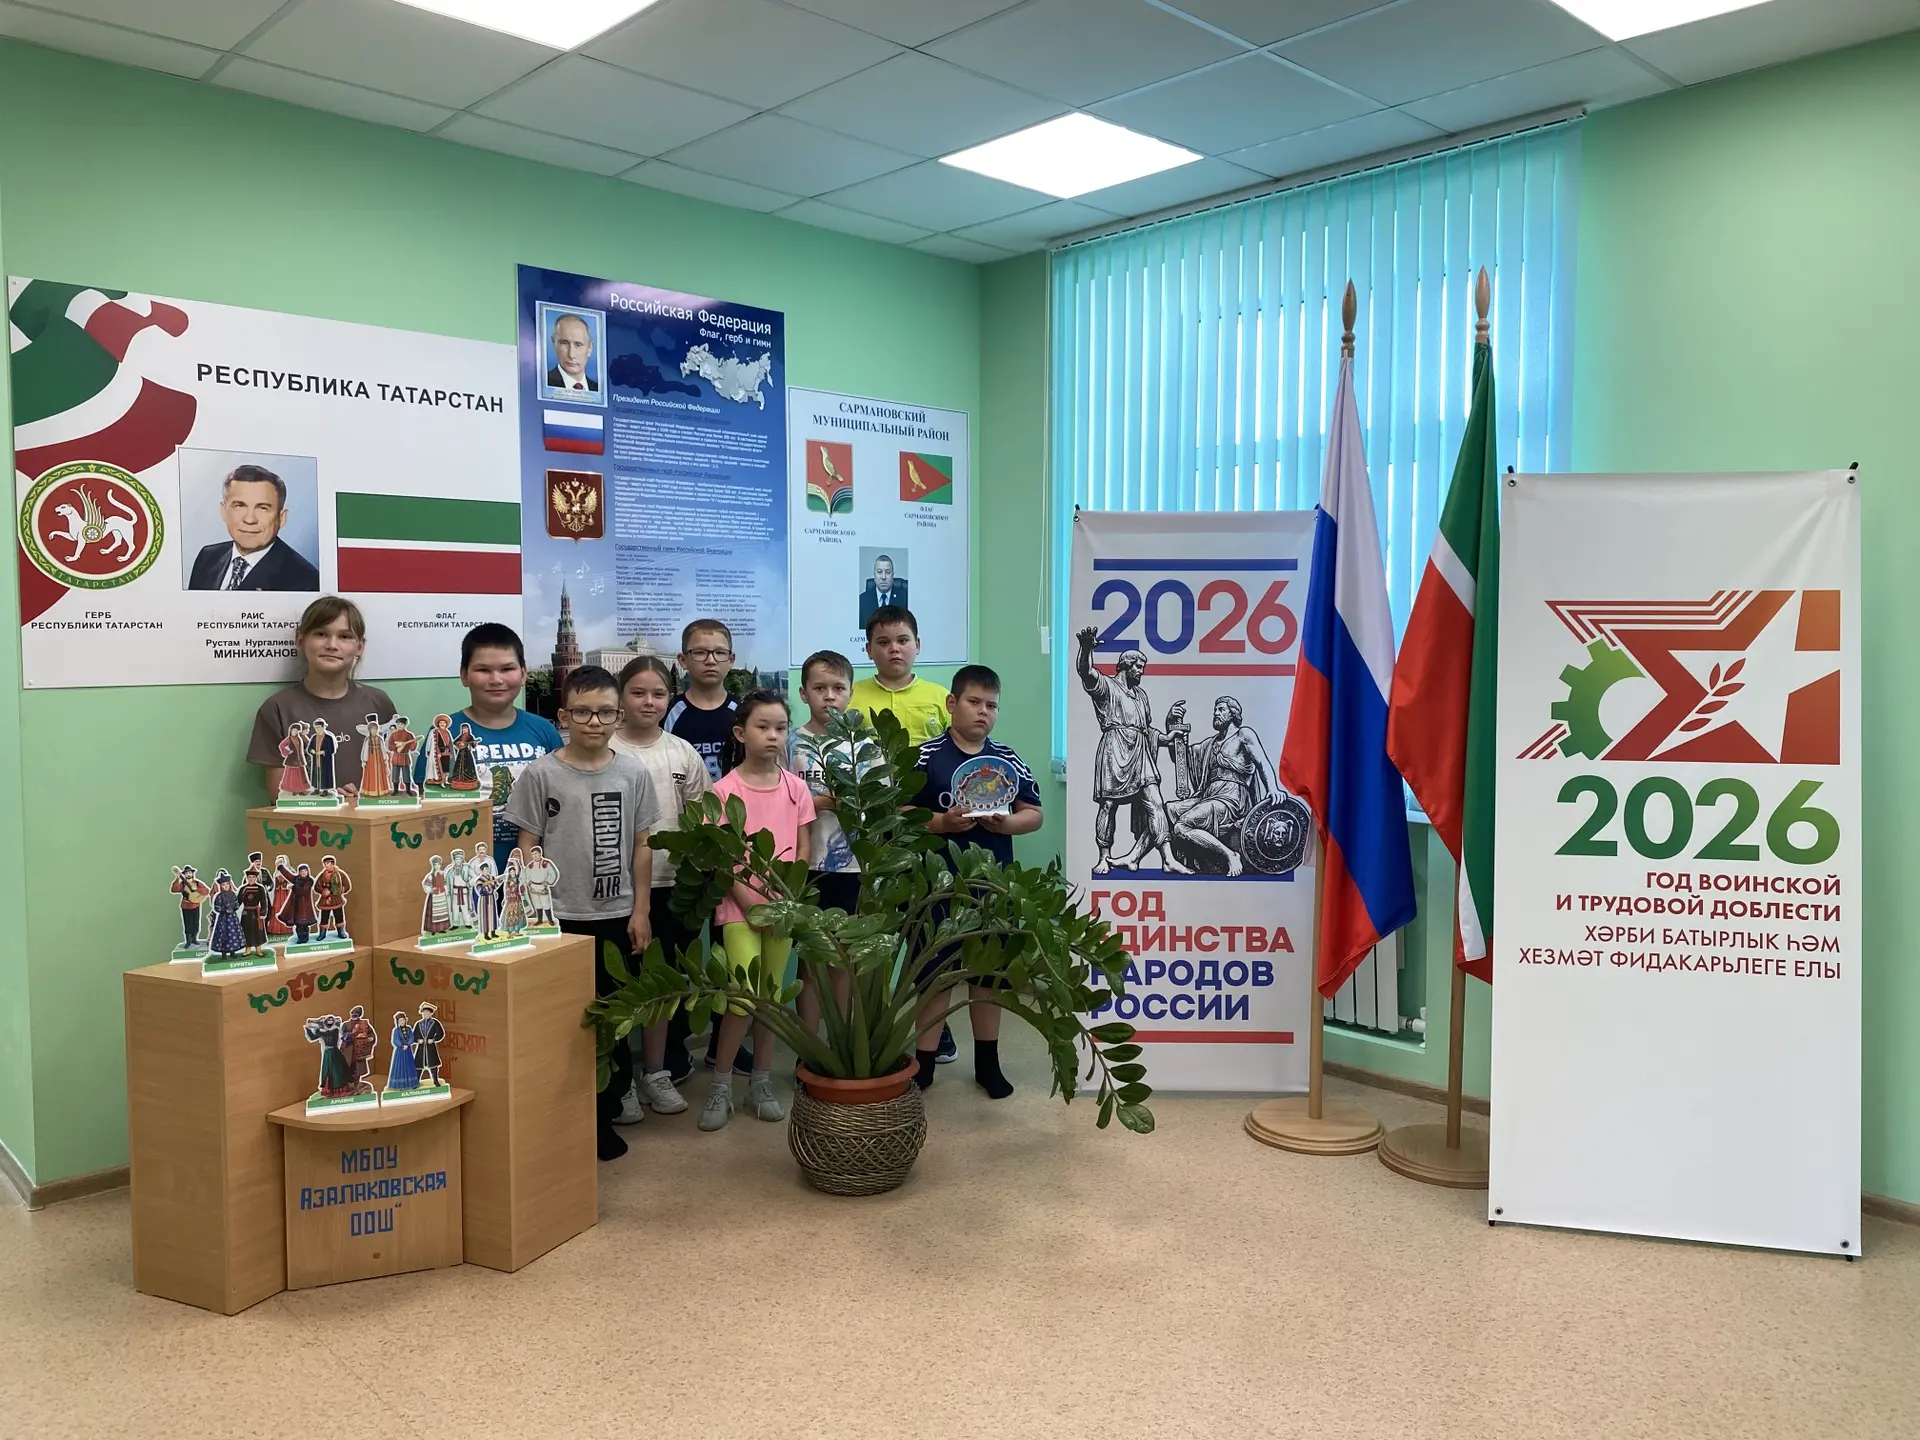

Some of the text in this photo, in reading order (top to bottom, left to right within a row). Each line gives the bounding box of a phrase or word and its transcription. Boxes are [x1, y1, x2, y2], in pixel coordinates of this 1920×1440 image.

[610, 292, 772, 335] Российская Федерация
[699, 327, 772, 349] Флаг, герб и гимн
[197, 363, 505, 413] РЕСПУБЛИКА ТАТАРСТАН
[612, 393, 650, 406] Президент
[651, 398, 687, 410] Российской
[839, 402, 927, 423] САРМАНОВСКИЙ
[812, 414, 950, 441] МУНИЦИПАЛЬНЫЙ РАЙОН
[804, 528, 856, 536] САРМАНОВСКОГО
[818, 535, 842, 544] РАЙОНА
[57, 573, 135, 589] ТАТАРСТАН
[31, 621, 163, 630] РЕСПУБЛИКИ ТАТАРСТАН
[85, 611, 112, 619] ГЕРБ
[197, 621, 259, 629] РЕСПУБЛИКИ
[241, 612, 265, 620] РАИС
[397, 621, 493, 629] РЕСПУБЛИКИ ТАТАРС
[436, 612, 457, 620] ФЛАГ
[1091, 579, 1299, 655] 2026
[206, 638, 297, 648] Рустам Нургалиев
[214, 649, 299, 659] МИННИХАНОВ
[693, 741, 725, 754] ZBC
[1554, 774, 1841, 865] 2026
[592, 793, 621, 876] JORDAN
[592, 875, 621, 898] AIR
[1647, 871, 1841, 896] ГОД ВОИНСКОЙ
[1091, 890, 1166, 922] ГОД
[1556, 894, 1841, 922] И ТРУДОВОЙ ДОБЛЕСТИ
[1098, 925, 1295, 956] ДИНСТВА
[1584, 925, 1655, 944] ХӘРБИ
[1662, 928, 1780, 951] БАТЫРЛЫК
[1519, 947, 1841, 979] ХЕЗМӘТ ФИДАКАРЬЛЕГЕ ЕЛЫ
[341, 1145, 398, 1174] МБОУ
[301, 1171, 447, 1210] АЗАЛАКОВСКАЯ
